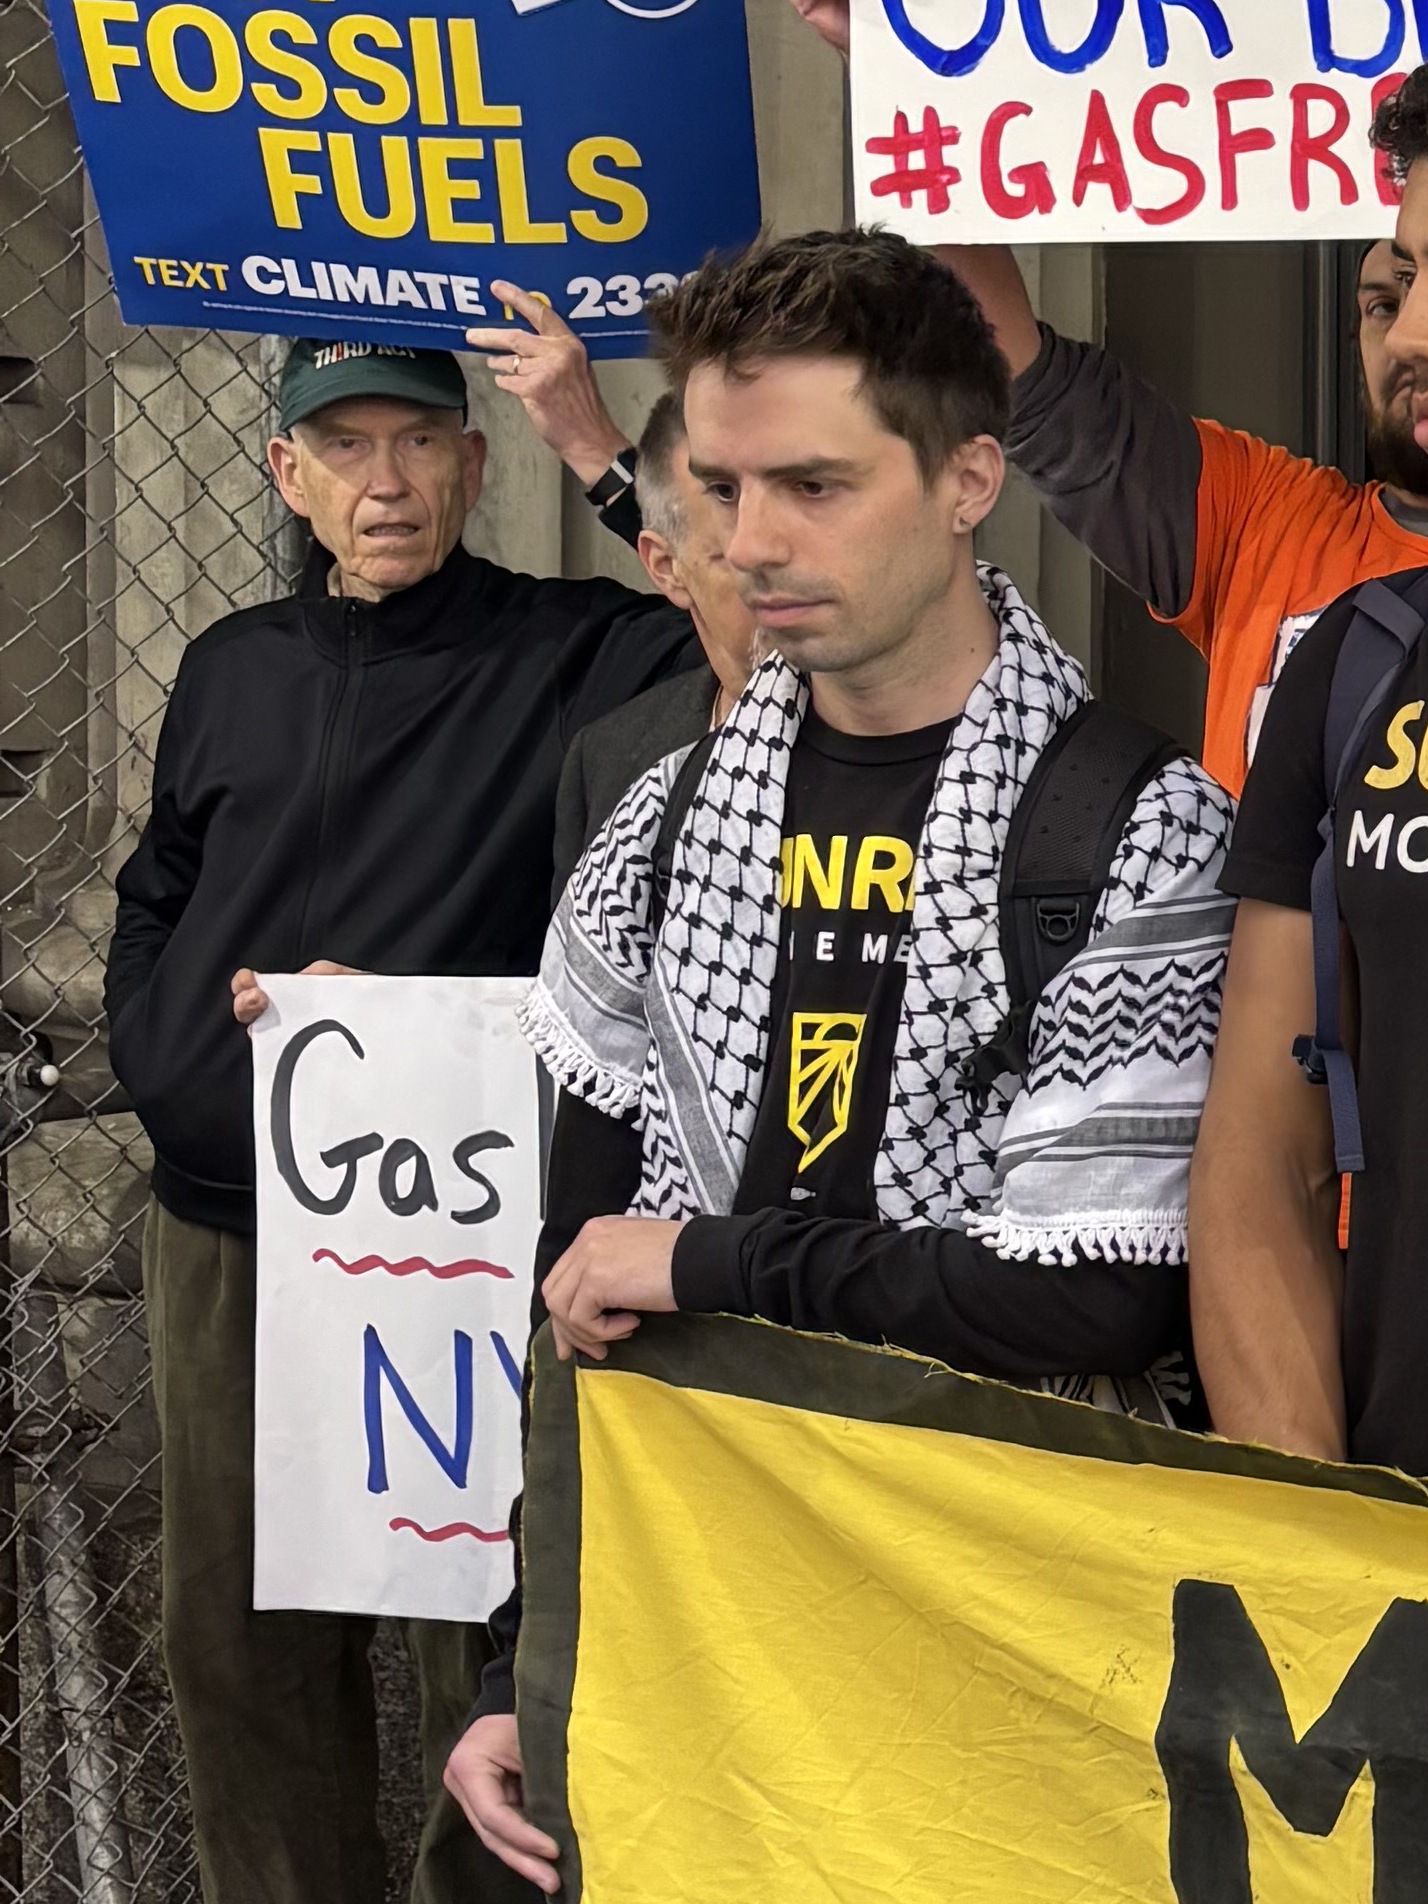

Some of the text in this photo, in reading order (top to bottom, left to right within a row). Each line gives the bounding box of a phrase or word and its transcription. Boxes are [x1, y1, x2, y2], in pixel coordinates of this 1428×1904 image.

[259, 127, 649, 244] FUELS
[134, 256, 229, 292] TEXT
[241, 255, 487, 316] CLIMATE
[270, 1019, 515, 1225] Gas
